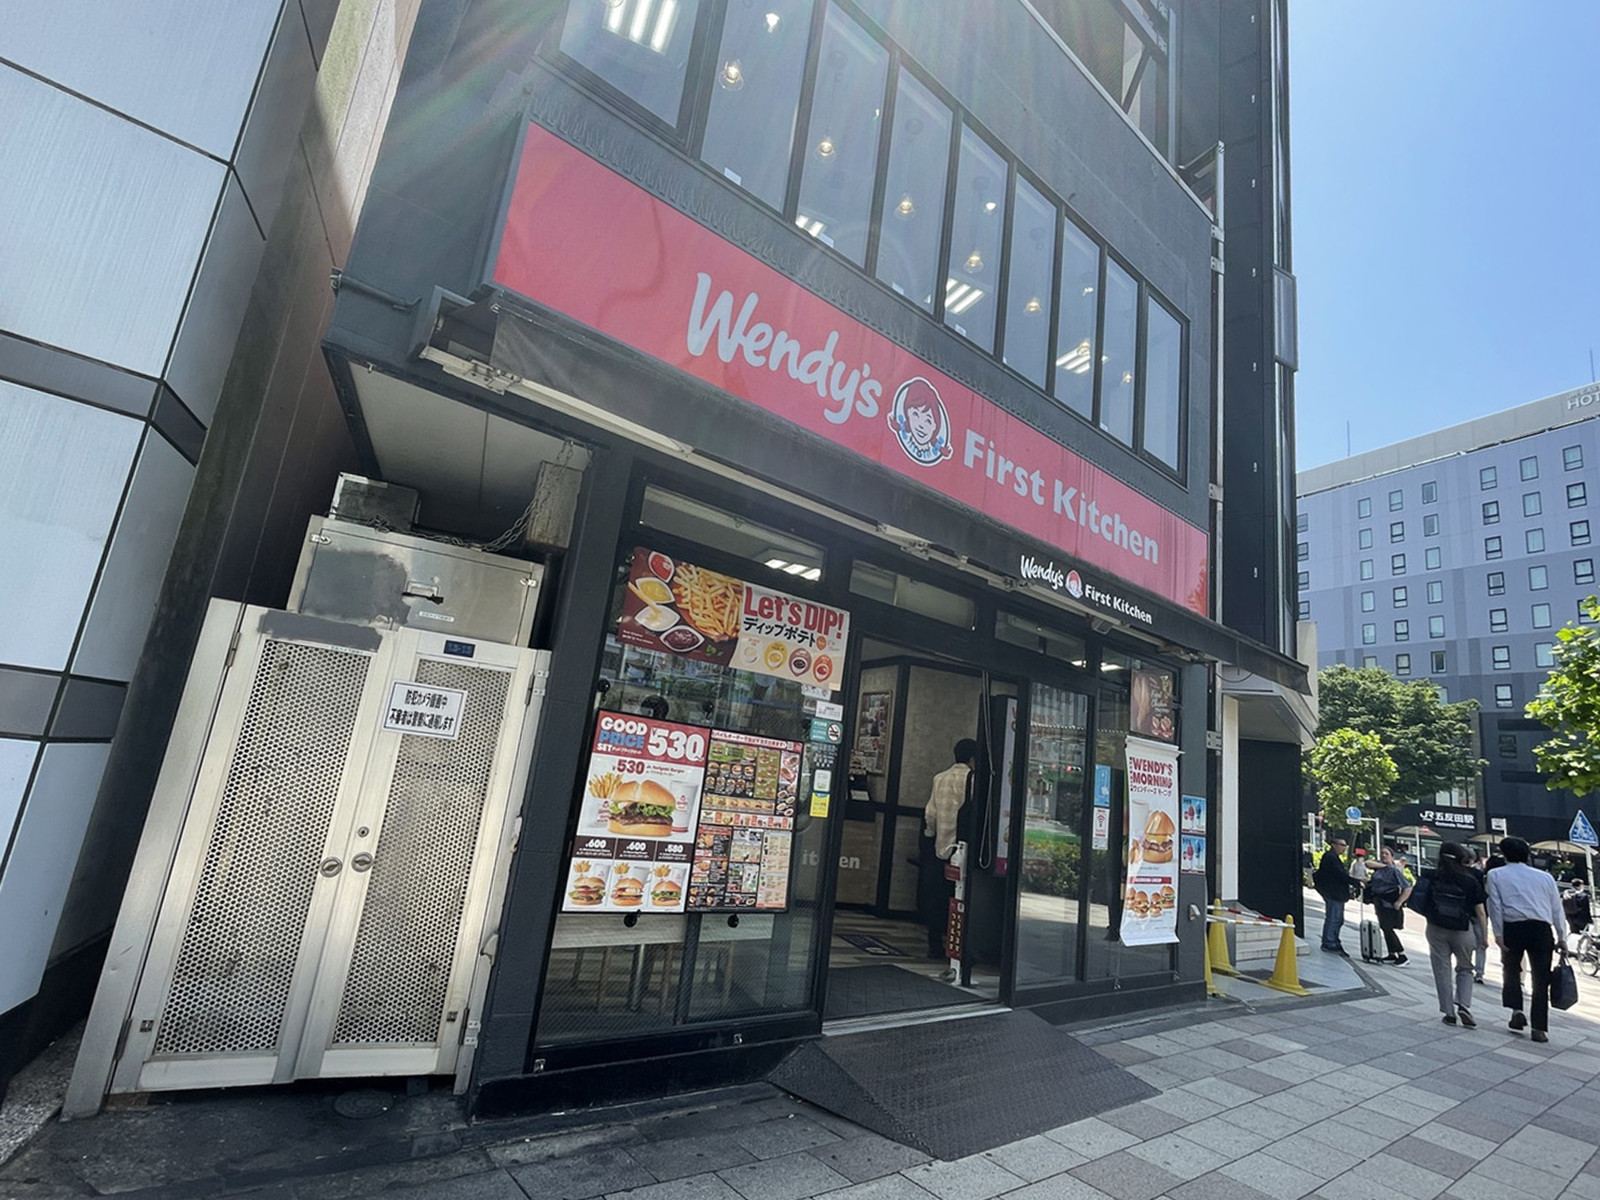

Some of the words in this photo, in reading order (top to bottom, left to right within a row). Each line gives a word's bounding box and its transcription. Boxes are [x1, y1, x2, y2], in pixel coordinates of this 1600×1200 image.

[686, 272, 882, 424] Wendy's
[963, 428, 1045, 507] First
[1053, 479, 1160, 565] Kitchen
[1020, 554, 1064, 590] Wendy's
[1085, 584, 1112, 607] First
[1112, 596, 1153, 625] Kitchen
[744, 586, 803, 627] Let's
[803, 603, 845, 640] DIP!
[600, 717, 648, 736] GOOD
[596, 742, 613, 753] SET
[599, 730, 645, 749] PRICE
[1132, 757, 1173, 776] WENDY'S
[1133, 771, 1173, 789] MORNING
[1435, 811, 1475, 824] 五反田駅
